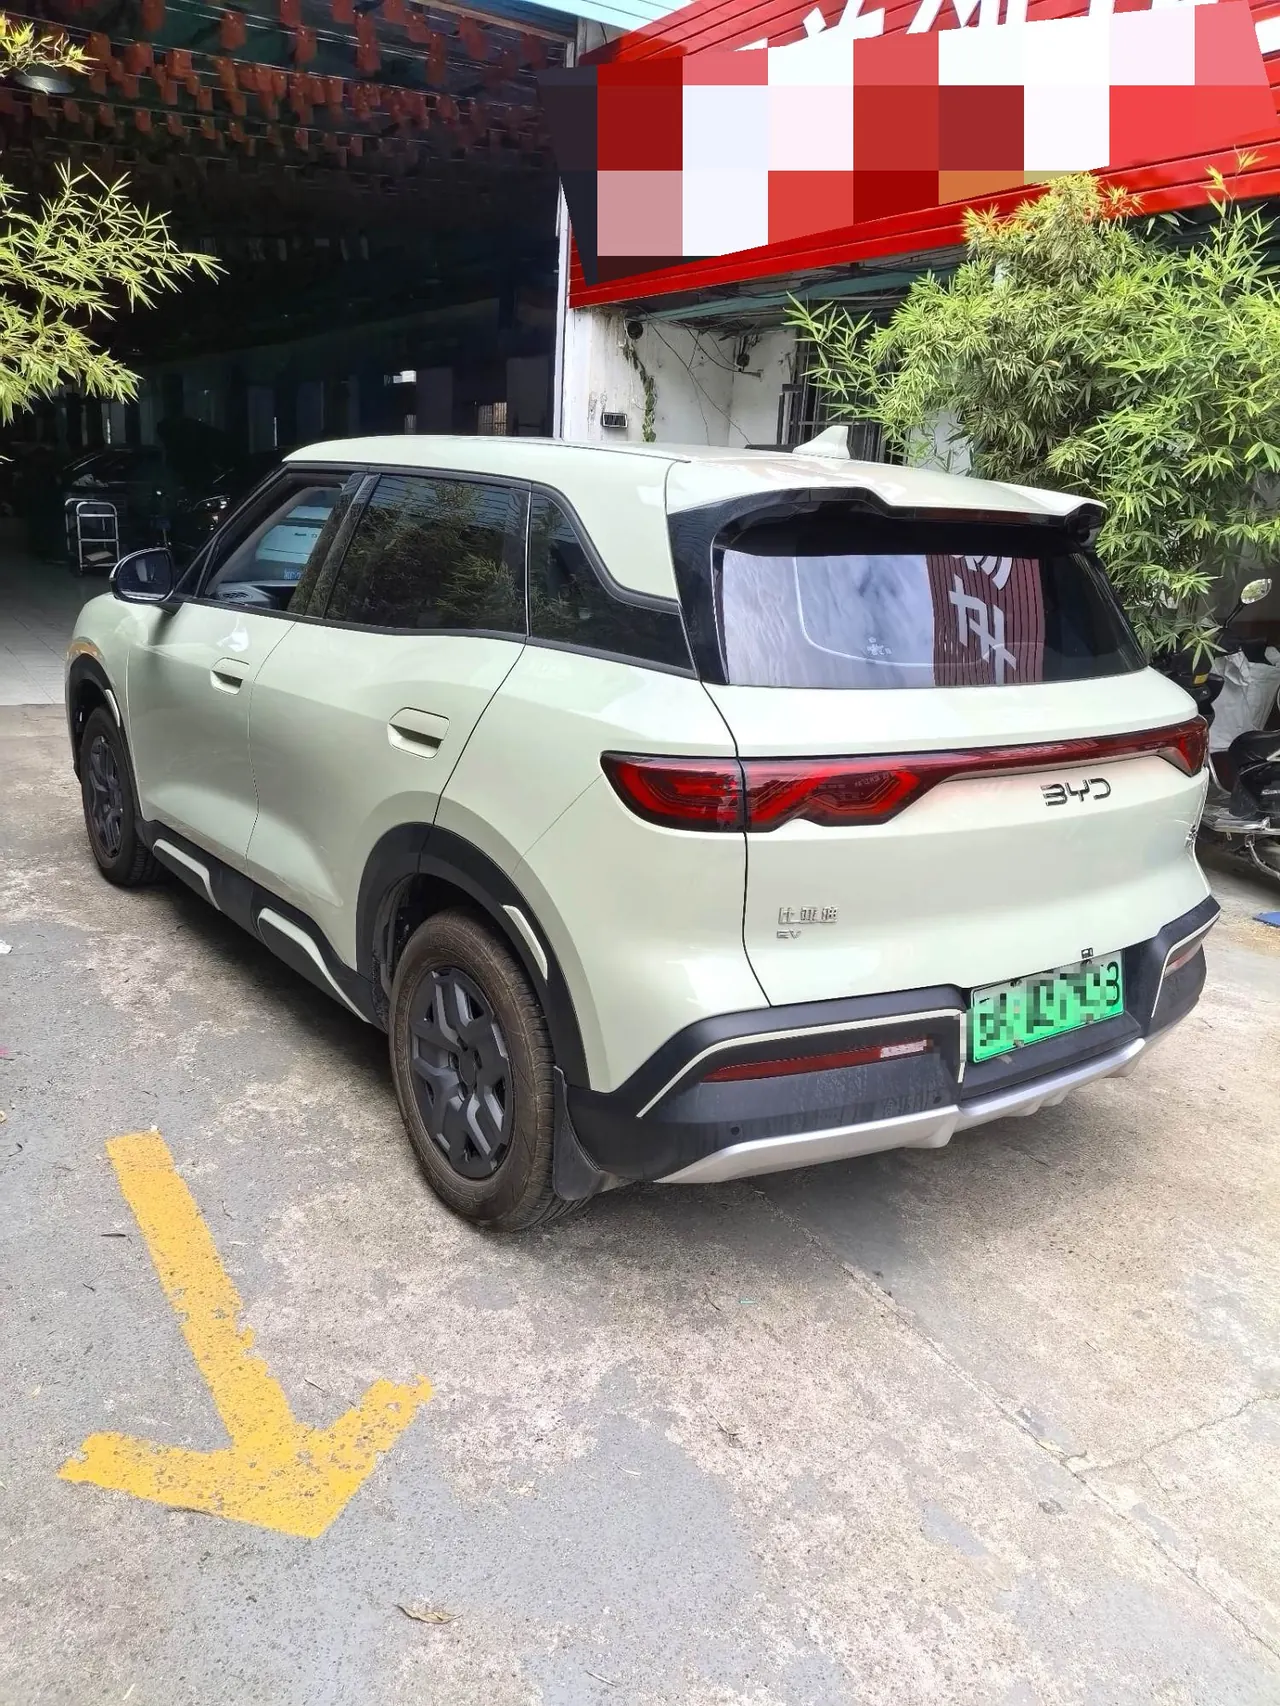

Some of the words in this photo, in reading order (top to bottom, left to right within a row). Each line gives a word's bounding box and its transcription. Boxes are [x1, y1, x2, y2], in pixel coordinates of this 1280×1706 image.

[1041, 778, 1111, 806] BYD
[778, 905, 839, 924] 比亚迪
[776, 929, 802, 939] EV
